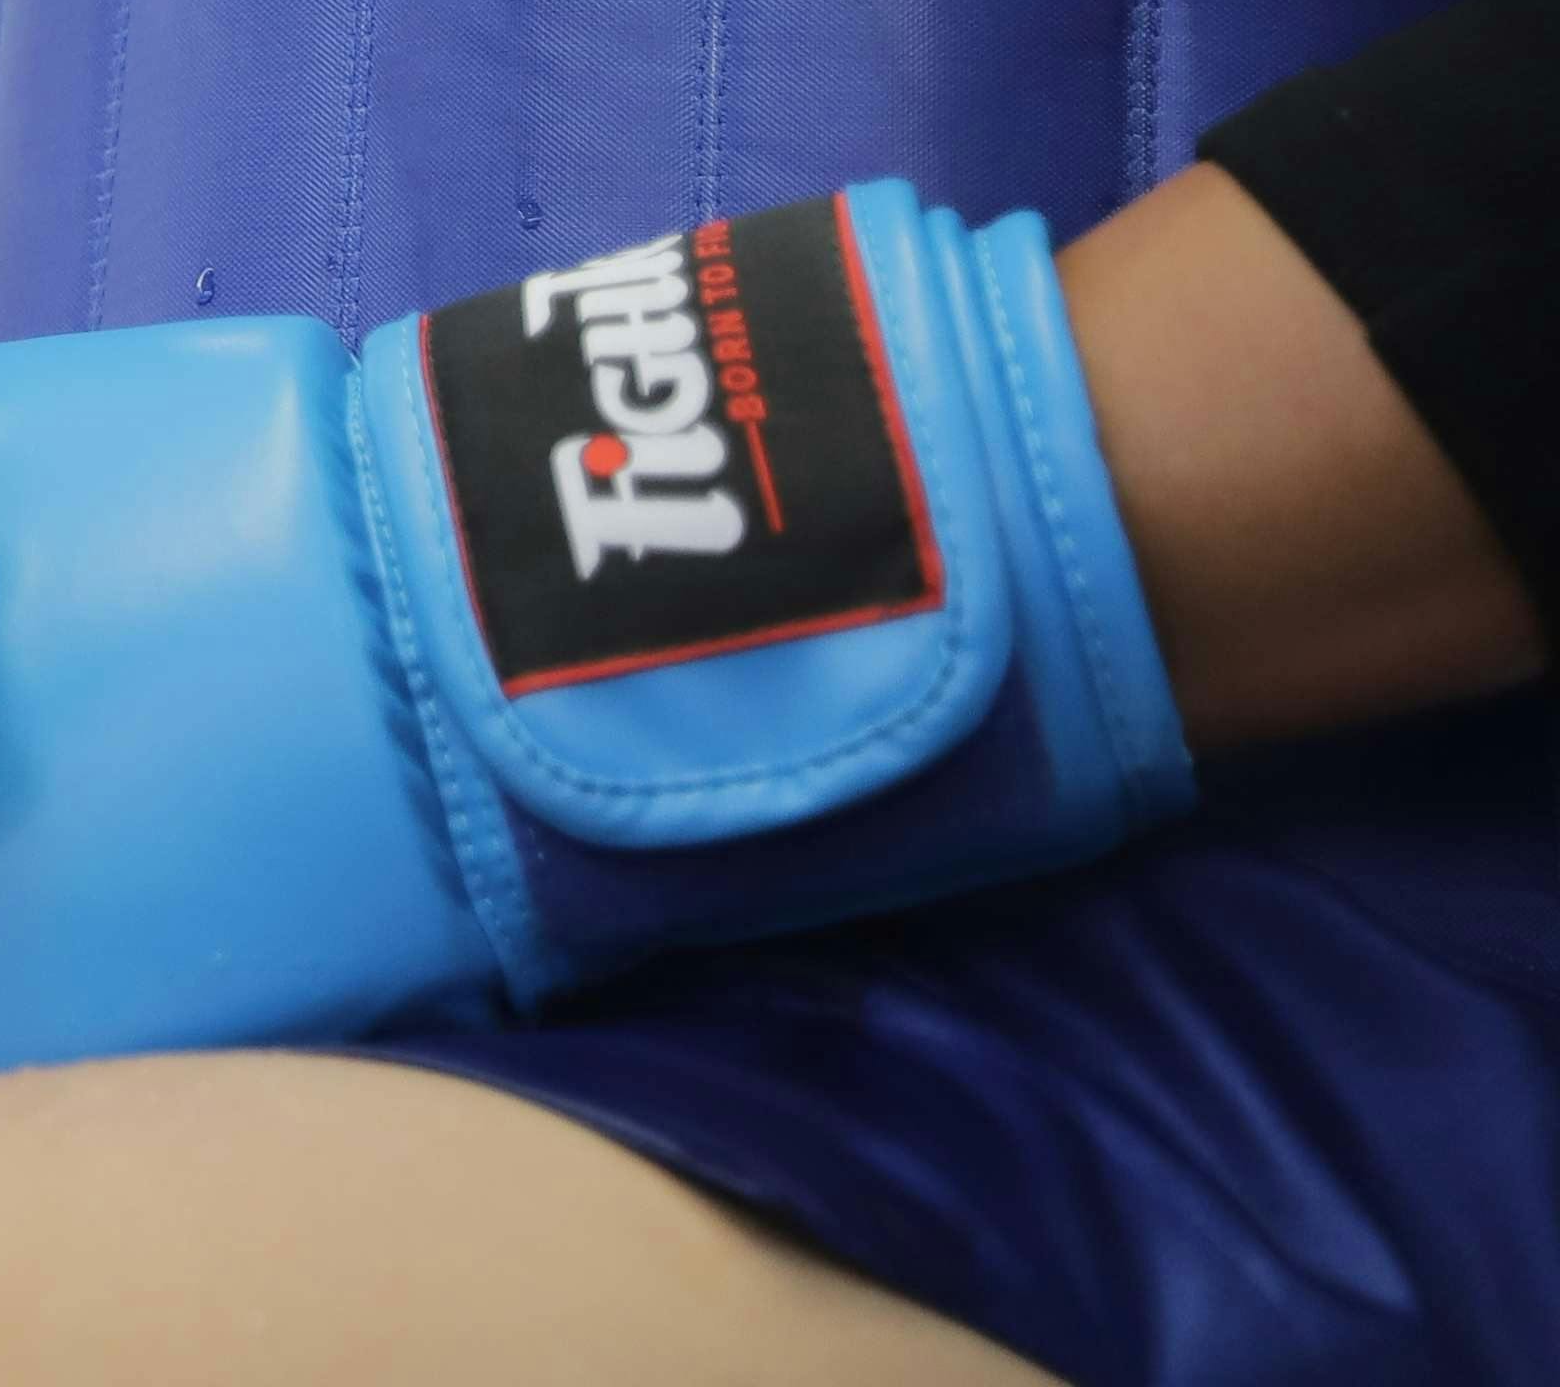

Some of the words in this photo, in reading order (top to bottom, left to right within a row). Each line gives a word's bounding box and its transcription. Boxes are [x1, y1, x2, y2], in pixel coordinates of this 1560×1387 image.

[696, 263, 740, 305] TO
[524, 234, 747, 580] FiGHT
[709, 308, 770, 424] BORN
